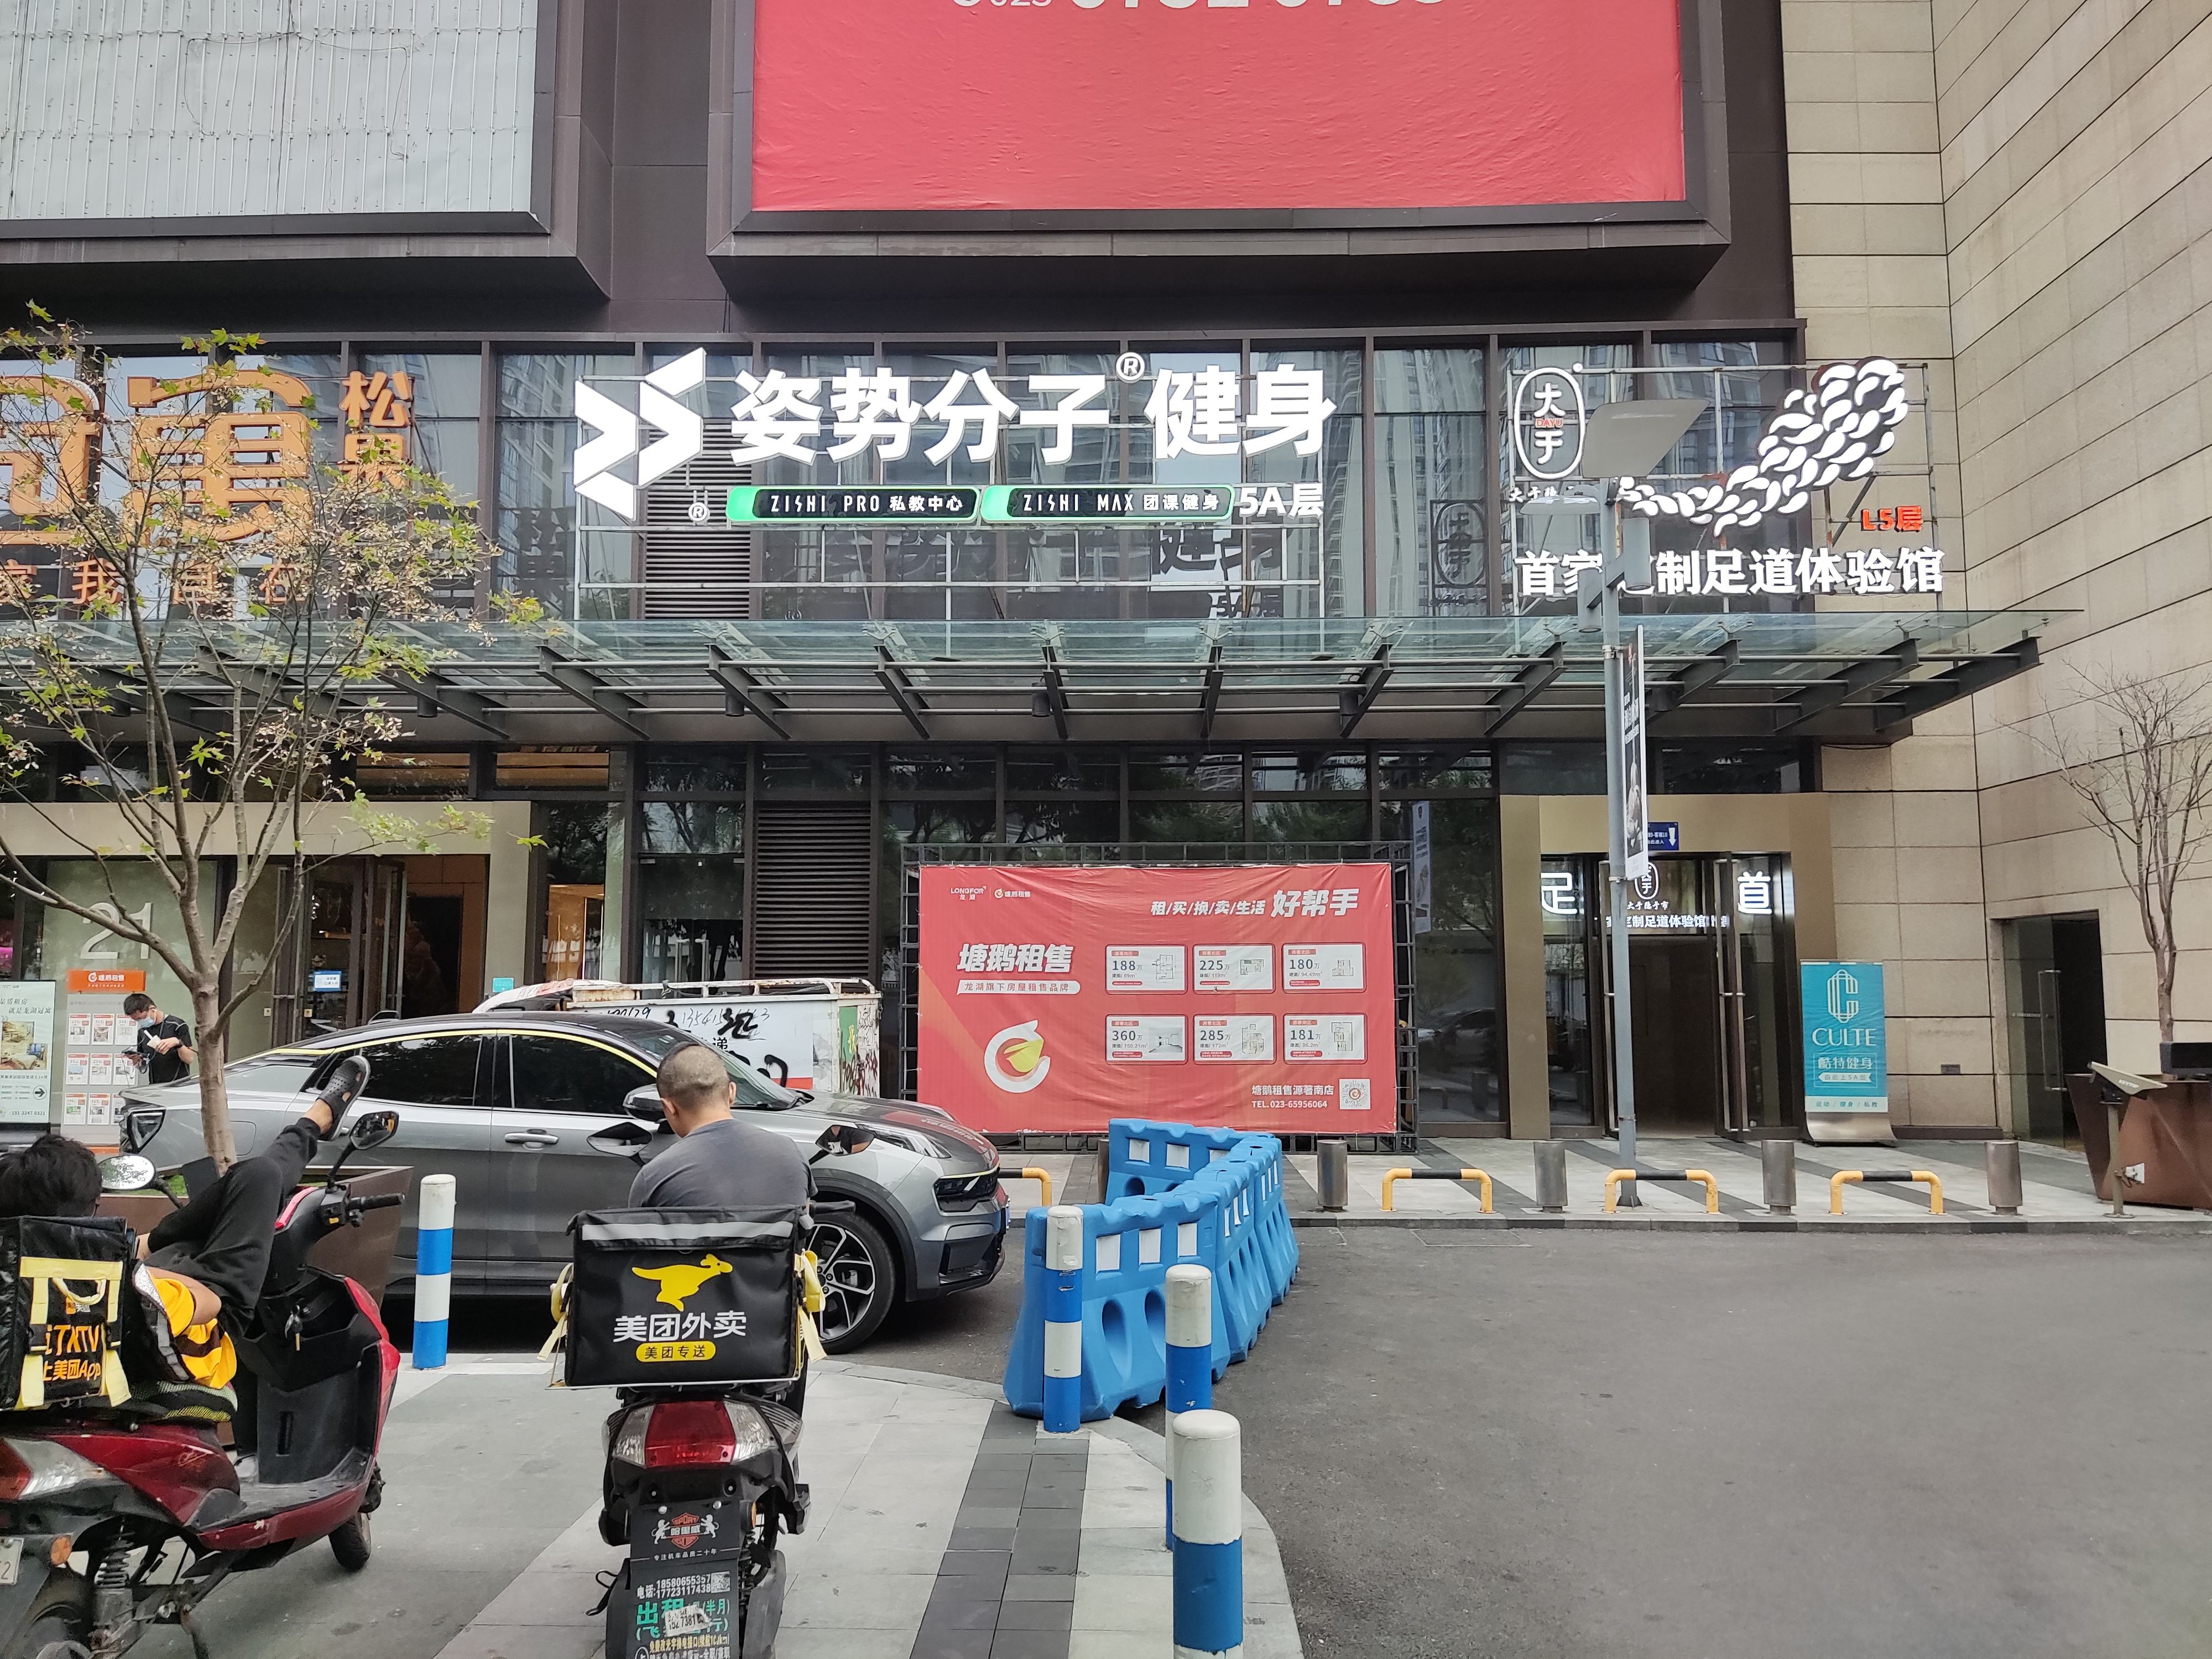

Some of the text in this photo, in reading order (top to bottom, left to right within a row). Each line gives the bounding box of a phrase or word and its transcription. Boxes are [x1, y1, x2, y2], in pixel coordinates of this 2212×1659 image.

[1535, 418, 1564, 429] DAYU
[770, 494, 963, 514] ZISHI PRO 私教中心
[1023, 493, 1220, 512] ZISHI MAX 团课健身
[1238, 483, 1325, 519] 5A层
[1860, 505, 1923, 533] L5层
[1151, 888, 1360, 919] 租/买/换/卖/生活 好帮手
[80, 902, 154, 959] 21
[956, 943, 1074, 974] 塘鹅租售
[964, 982, 1070, 993] 龙湖旗下房屋租售品牌
[1812, 1027, 1877, 1046] CULTE
[1817, 1056, 1873, 1070] 酷特健身
[1251, 1084, 1335, 1095] 塘鹅租售源著南店
[613, 1310, 746, 1343] 美团外卖
[644, 1344, 706, 1359] 美团专送
[654, 1548, 717, 1561] 专注机车品质二十年
[637, 1574, 711, 1599] 电话: 18580655357
[656, 1583, 711, 1599] 17723117438
